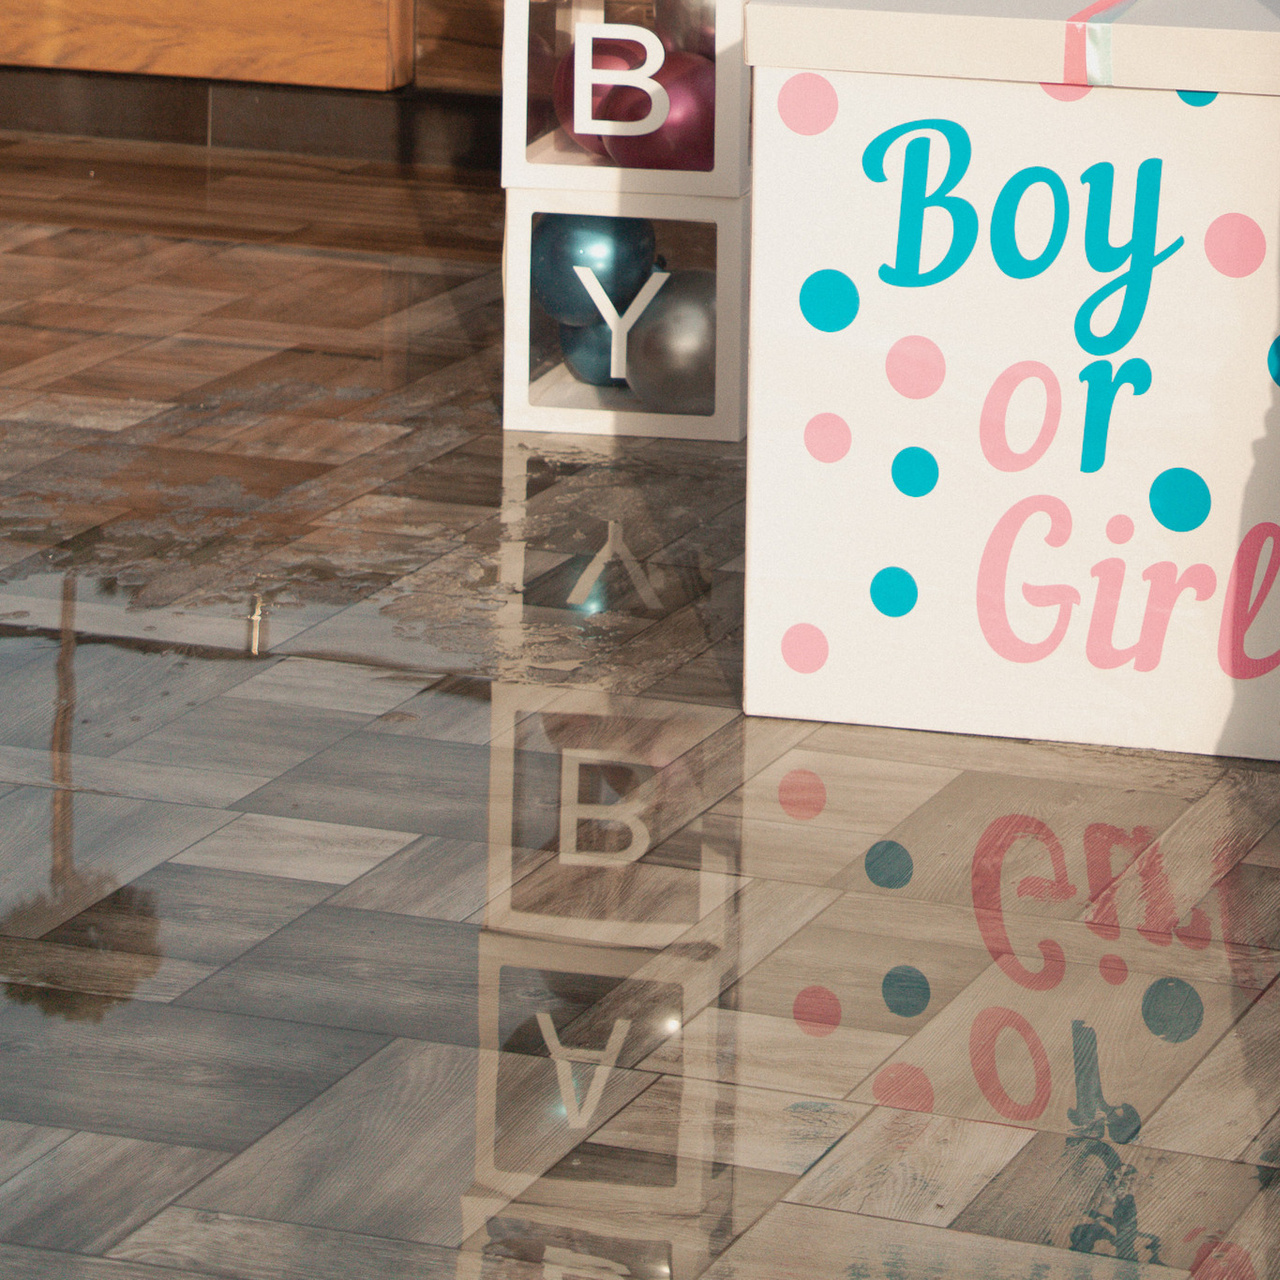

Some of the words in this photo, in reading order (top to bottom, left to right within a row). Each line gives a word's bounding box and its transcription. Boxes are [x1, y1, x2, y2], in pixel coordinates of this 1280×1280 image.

[573, 22, 671, 137] B
[861, 118, 1185, 356] Boy
[572, 265, 671, 379] Y
[979, 357, 1153, 474] or
